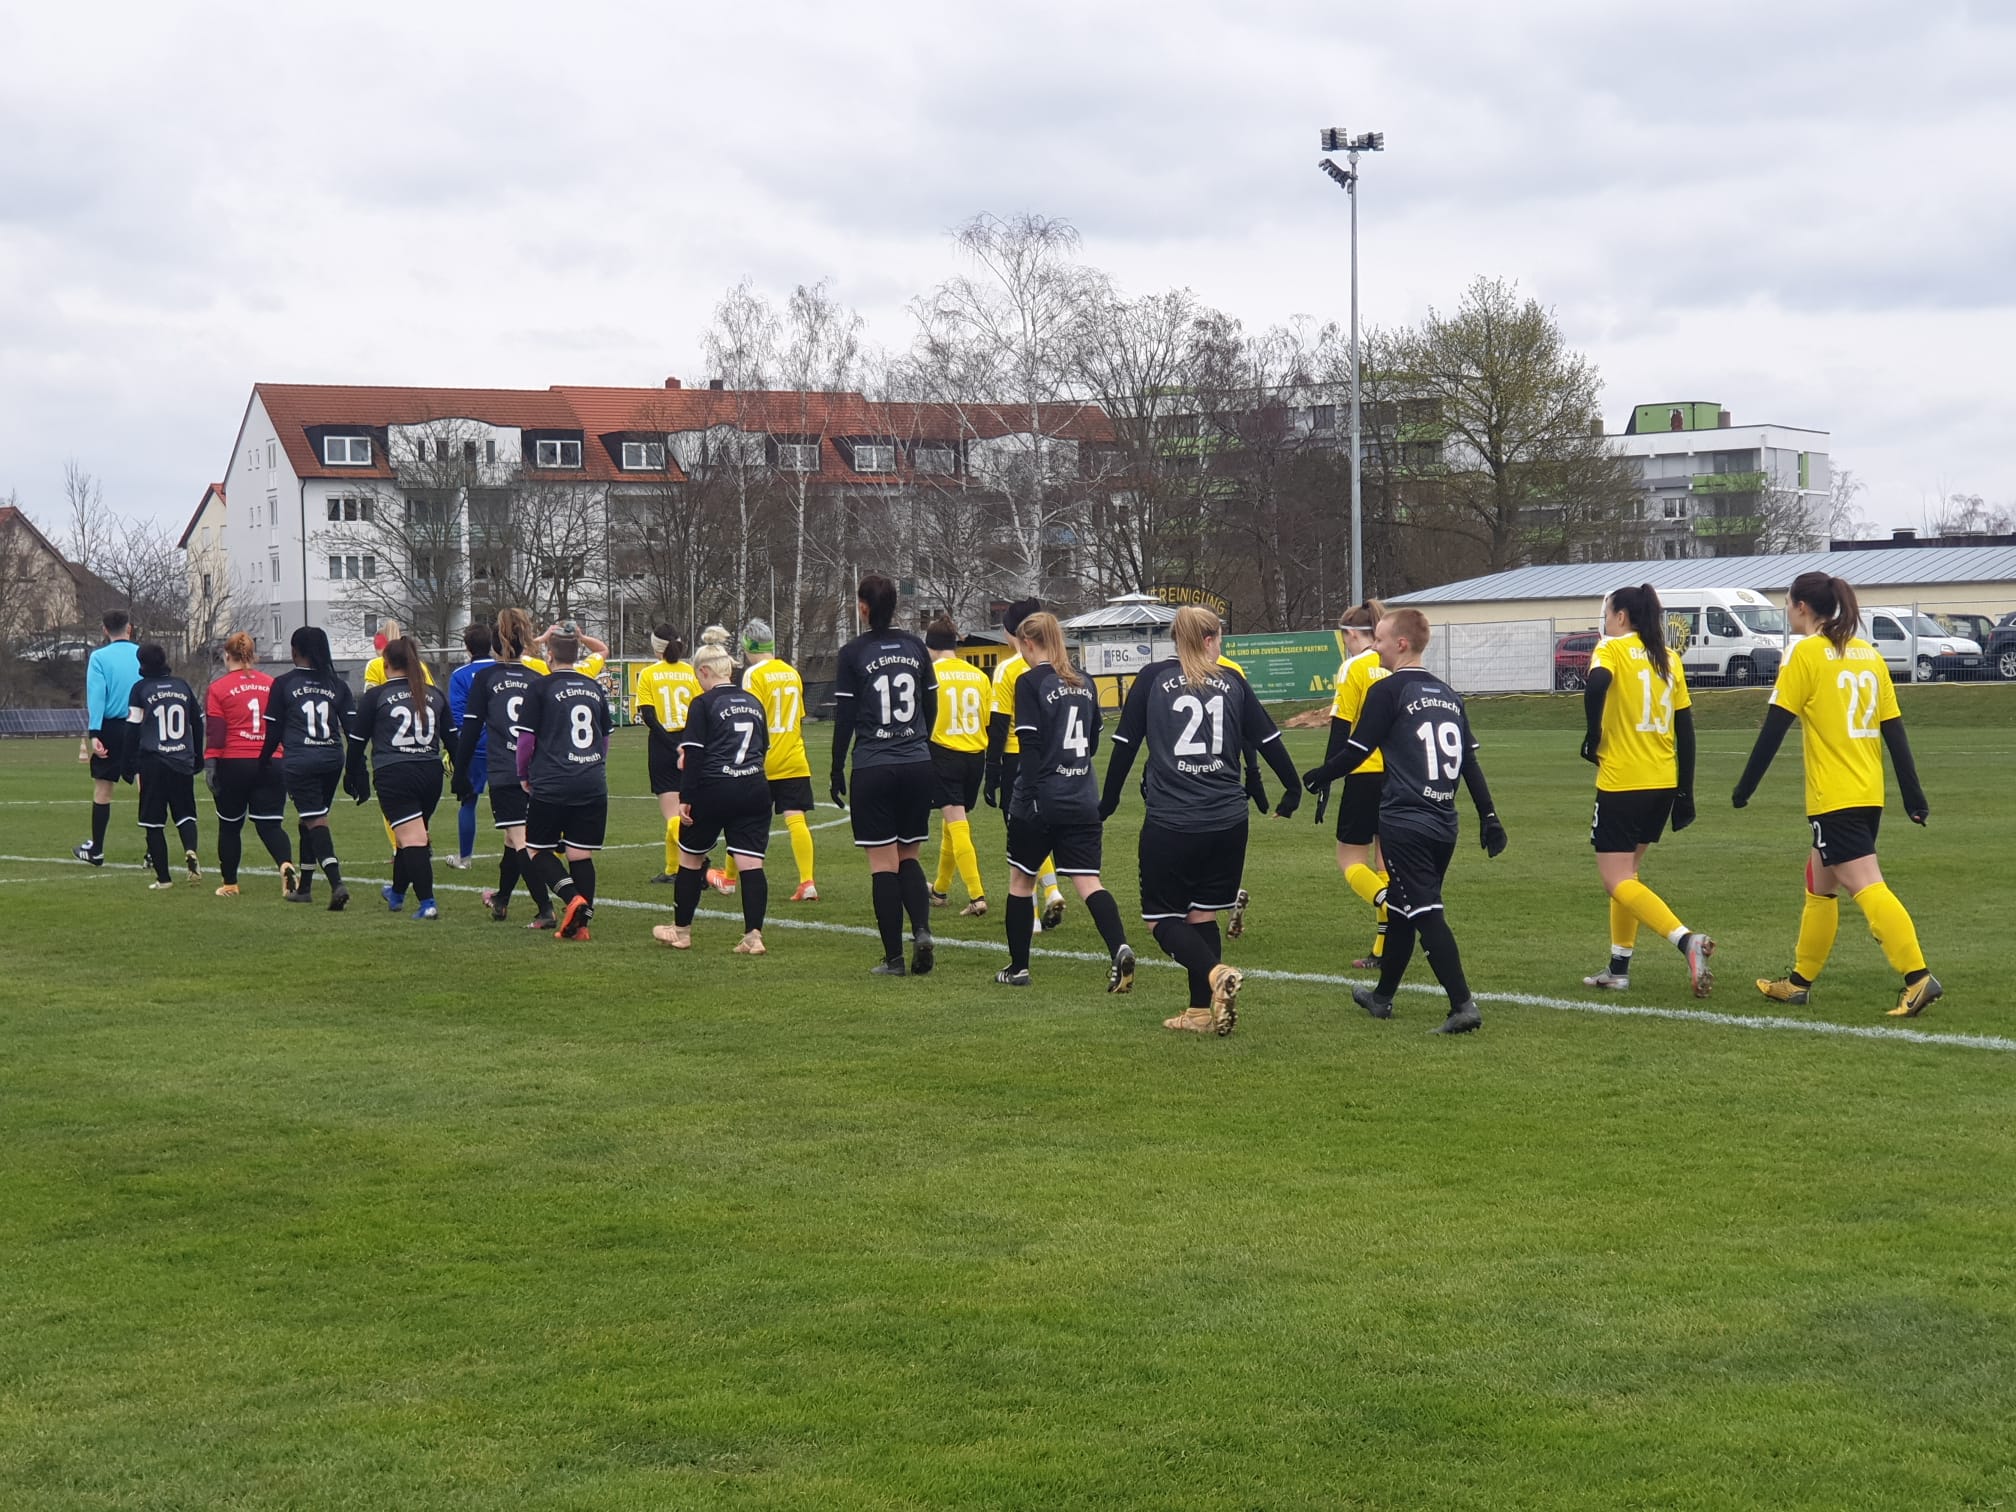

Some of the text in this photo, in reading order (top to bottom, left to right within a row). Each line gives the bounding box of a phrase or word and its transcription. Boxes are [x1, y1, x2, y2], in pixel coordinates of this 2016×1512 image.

[865, 655, 920, 674] FC Eintracht
[1111, 649, 1129, 662] FBG
[147, 691, 188, 705] FC Eintracht
[229, 684, 271, 697] FC Eintrach
[292, 688, 304, 698] FC
[492, 679, 529, 694] FC Eintra
[554, 691, 567, 702] FC
[873, 672, 916, 725] 13
[1046, 690, 1060, 704] FC
[1162, 675, 1231, 694] FC Eacht
[386, 694, 399, 705] FC
[658, 685, 690, 729] 16
[768, 686, 799, 733] 17
[945, 687, 980, 735] 18
[1406, 700, 1422, 716] FC
[1635, 668, 1675, 735] 13
[1837, 669, 1880, 739] 22
[153, 704, 185, 741] 10
[247, 697, 260, 734] 1
[301, 700, 331, 739] 11
[390, 705, 436, 747] 20
[570, 704, 594, 749] 8
[720, 708, 731, 720] FC
[1172, 694, 1224, 757] 21
[733, 722, 754, 765] 7
[1063, 705, 1088, 758] 4
[568, 752, 602, 764] Bayreuth
[1416, 721, 1463, 781] 19
[722, 765, 760, 777] Bayreuth
[1177, 759, 1225, 775] Bayreuth
